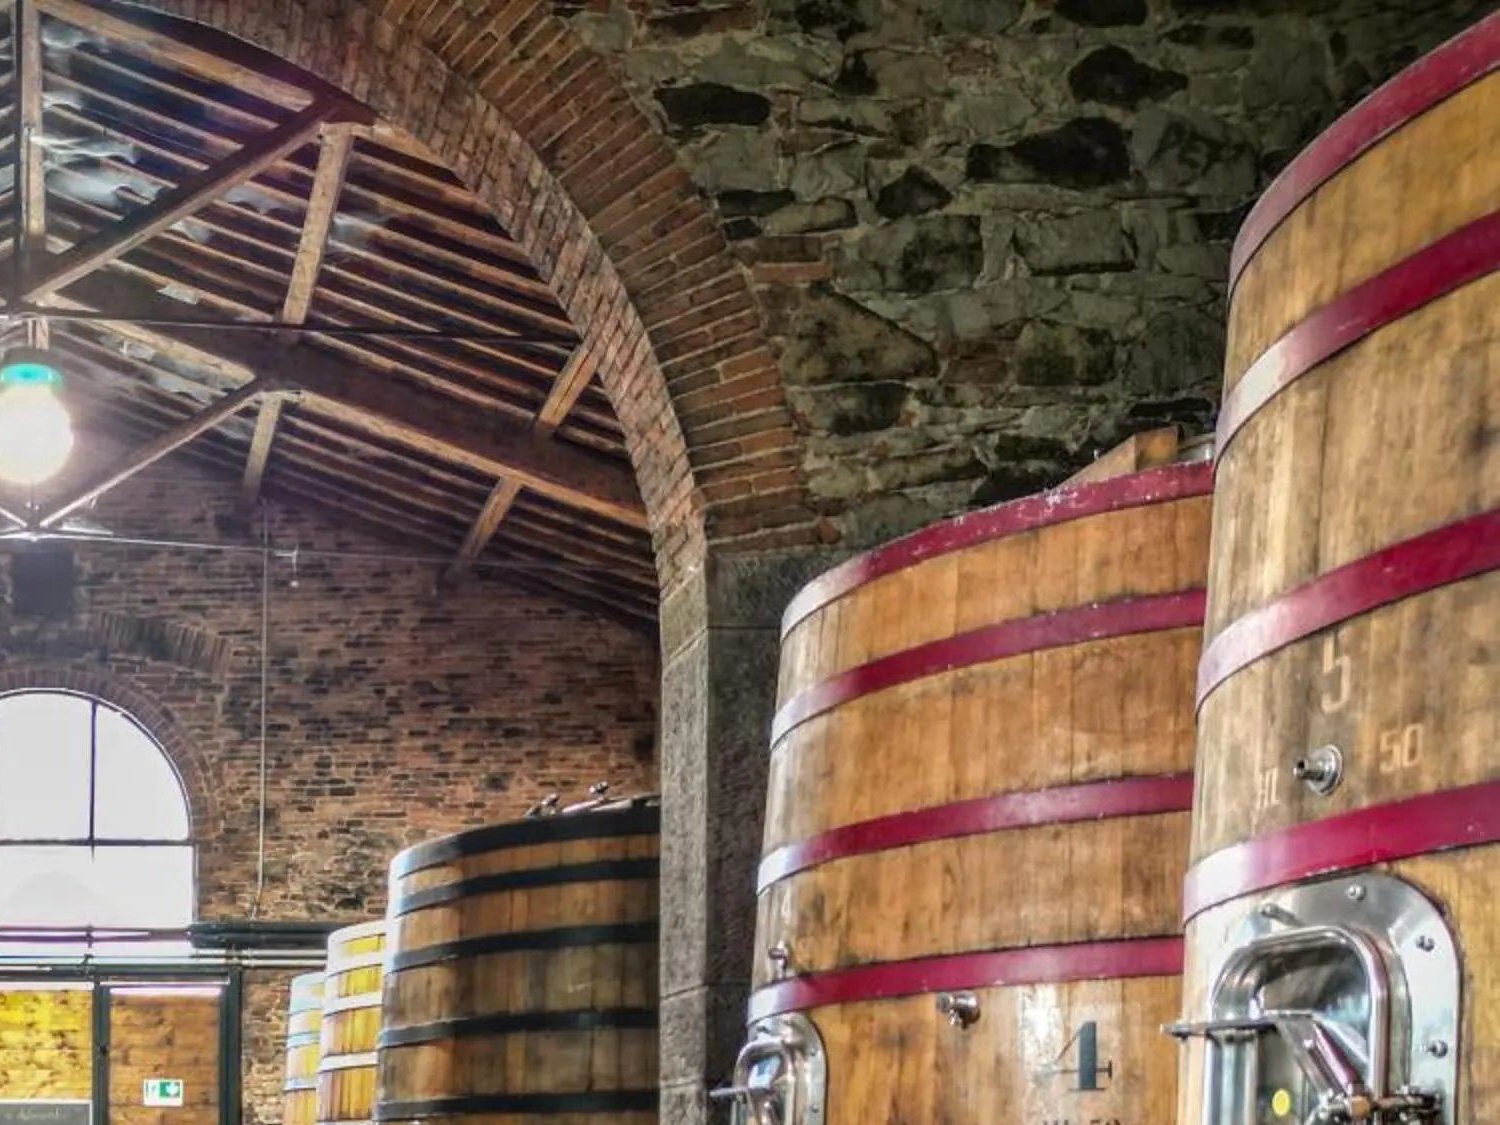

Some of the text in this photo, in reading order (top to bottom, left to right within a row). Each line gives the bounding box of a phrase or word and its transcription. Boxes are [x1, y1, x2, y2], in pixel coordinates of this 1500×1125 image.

[1321, 626, 1351, 714] 5
[1379, 722, 1424, 774] 50
[1051, 1021, 1113, 1091] 4
